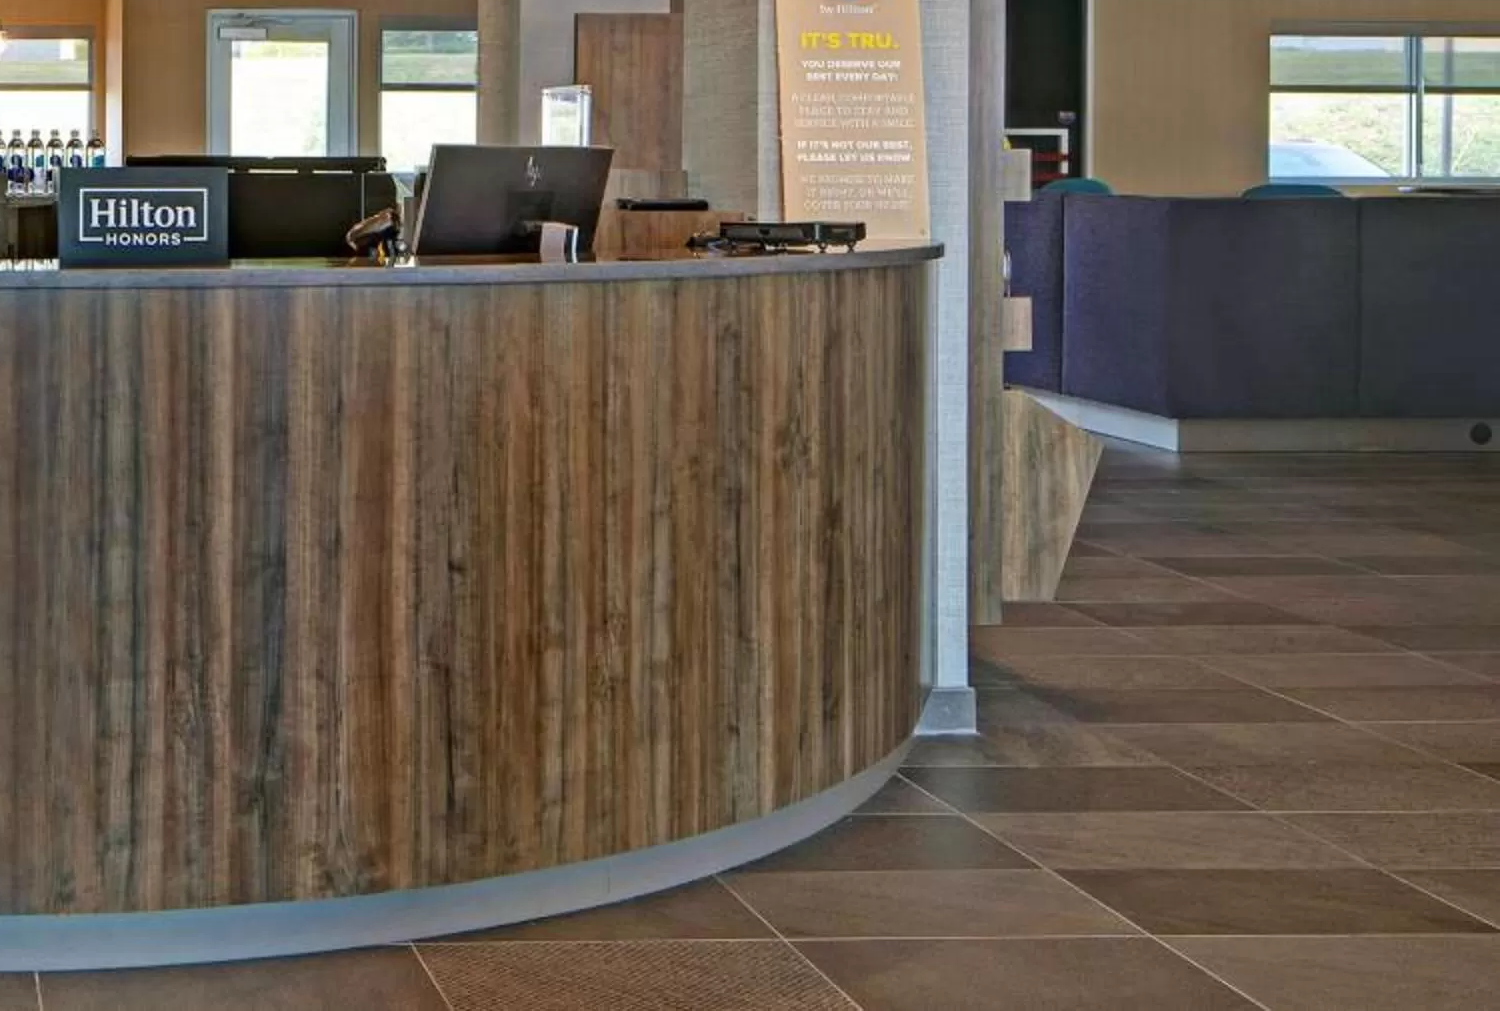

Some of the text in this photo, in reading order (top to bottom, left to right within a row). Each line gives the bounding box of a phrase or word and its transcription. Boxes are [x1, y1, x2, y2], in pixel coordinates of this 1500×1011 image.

[800, 32, 900, 49] IT'S TRU.
[801, 60, 825, 69] YOU
[877, 60, 901, 69] OUR
[805, 72, 832, 81] BEST
[835, 72, 870, 81] EVERY
[796, 140, 807, 150] IF
[809, 140, 829, 150] IT'S
[831, 140, 854, 150] NOT
[855, 140, 881, 150] OUR
[796, 152, 837, 162] PLEASE
[839, 152, 858, 162] LET
[860, 152, 875, 162] US
[90, 198, 197, 228] Hilton
[106, 232, 181, 246] HONORS
